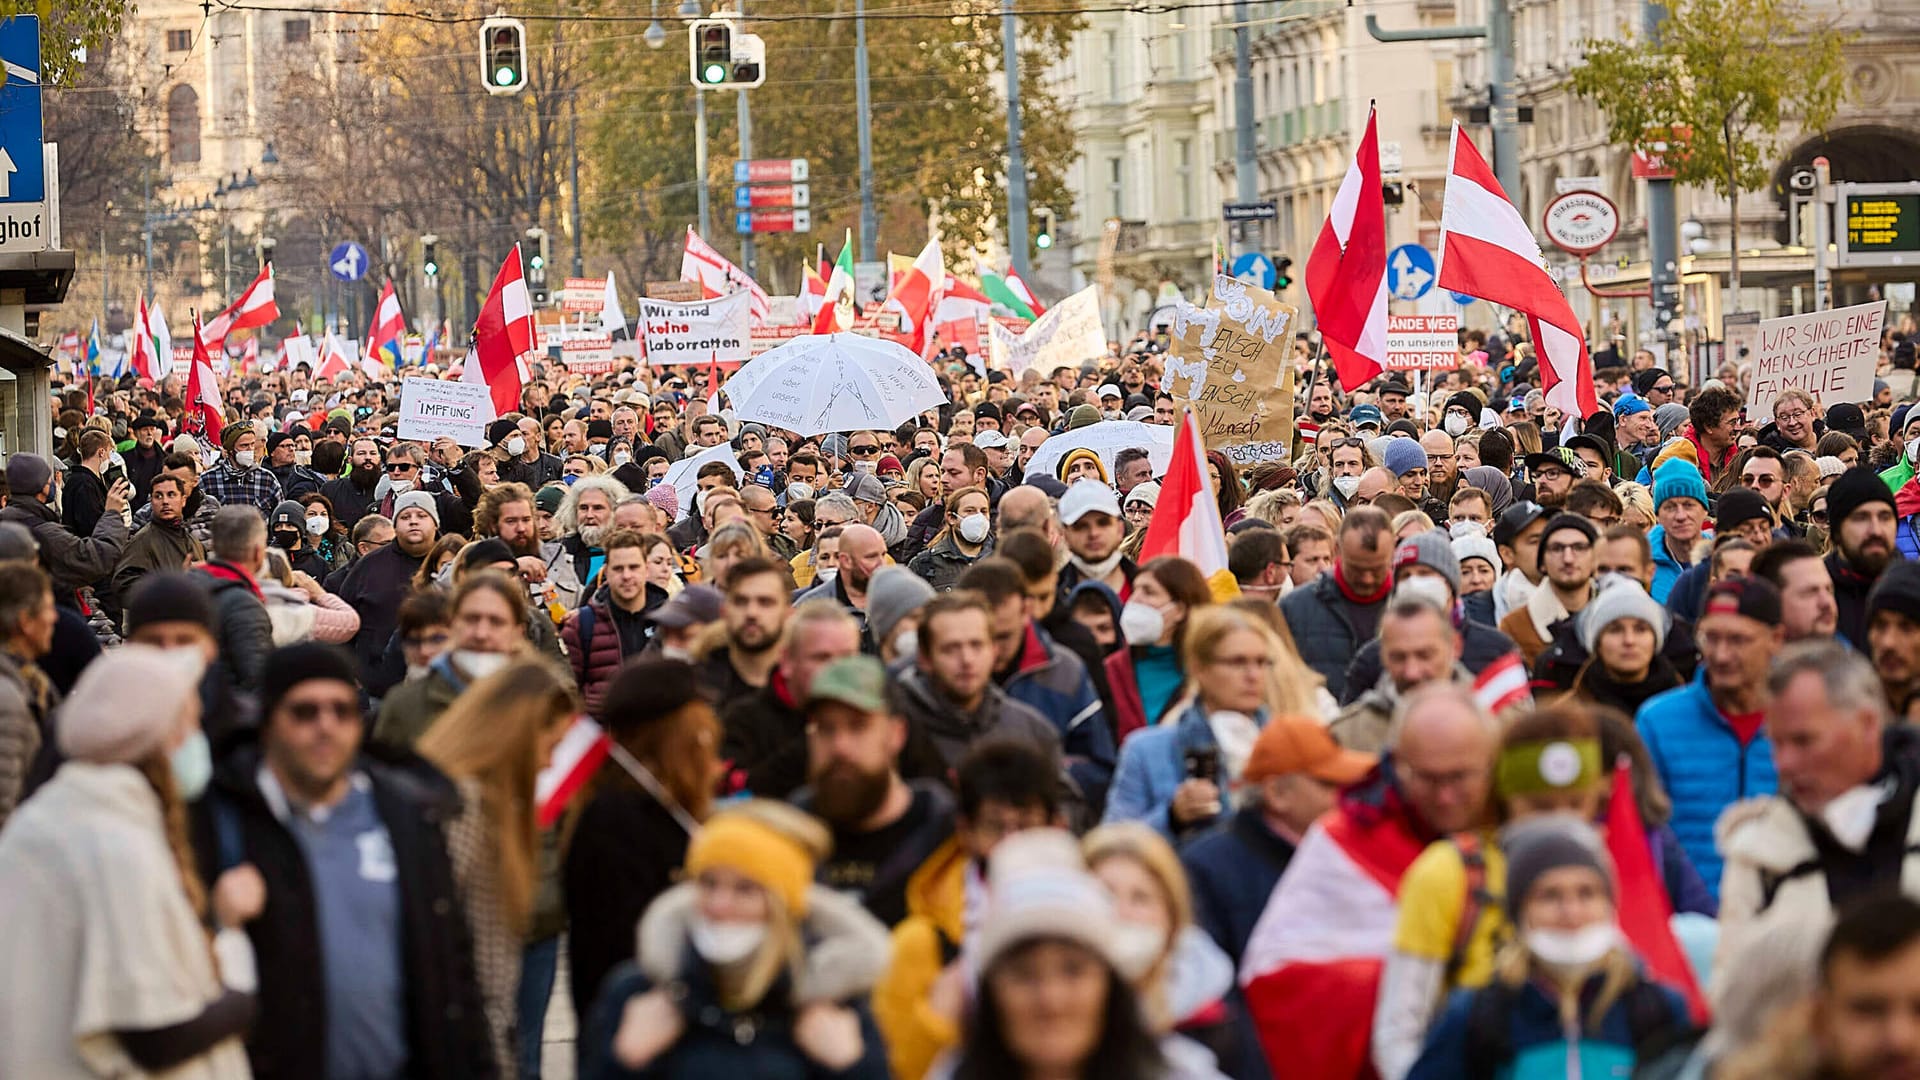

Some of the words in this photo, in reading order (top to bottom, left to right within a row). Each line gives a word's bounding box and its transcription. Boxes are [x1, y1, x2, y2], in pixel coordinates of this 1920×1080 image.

[644, 304, 673, 318] Wir
[678, 304, 710, 317] sind
[647, 320, 690, 335] keine
[1388, 315, 1424, 331] ÄNDE
[1426, 317, 1456, 331] WEG
[1763, 325, 1797, 352] WIR
[1800, 319, 1842, 345] SIND
[1846, 311, 1881, 336] EINE
[563, 340, 612, 350] GEMEINSAM
[649, 338, 740, 352] Laborratten
[1210, 355, 1238, 376] ZU
[1387, 353, 1455, 367] KINDERN
[1758, 338, 1878, 377] MENSCHHEITS-
[898, 365, 929, 390] Angst
[1754, 366, 1847, 406] FAMILIE
[771, 391, 801, 405] unsere
[755, 404, 803, 425] Gesundheit
[1202, 411, 1260, 441] Mensch
